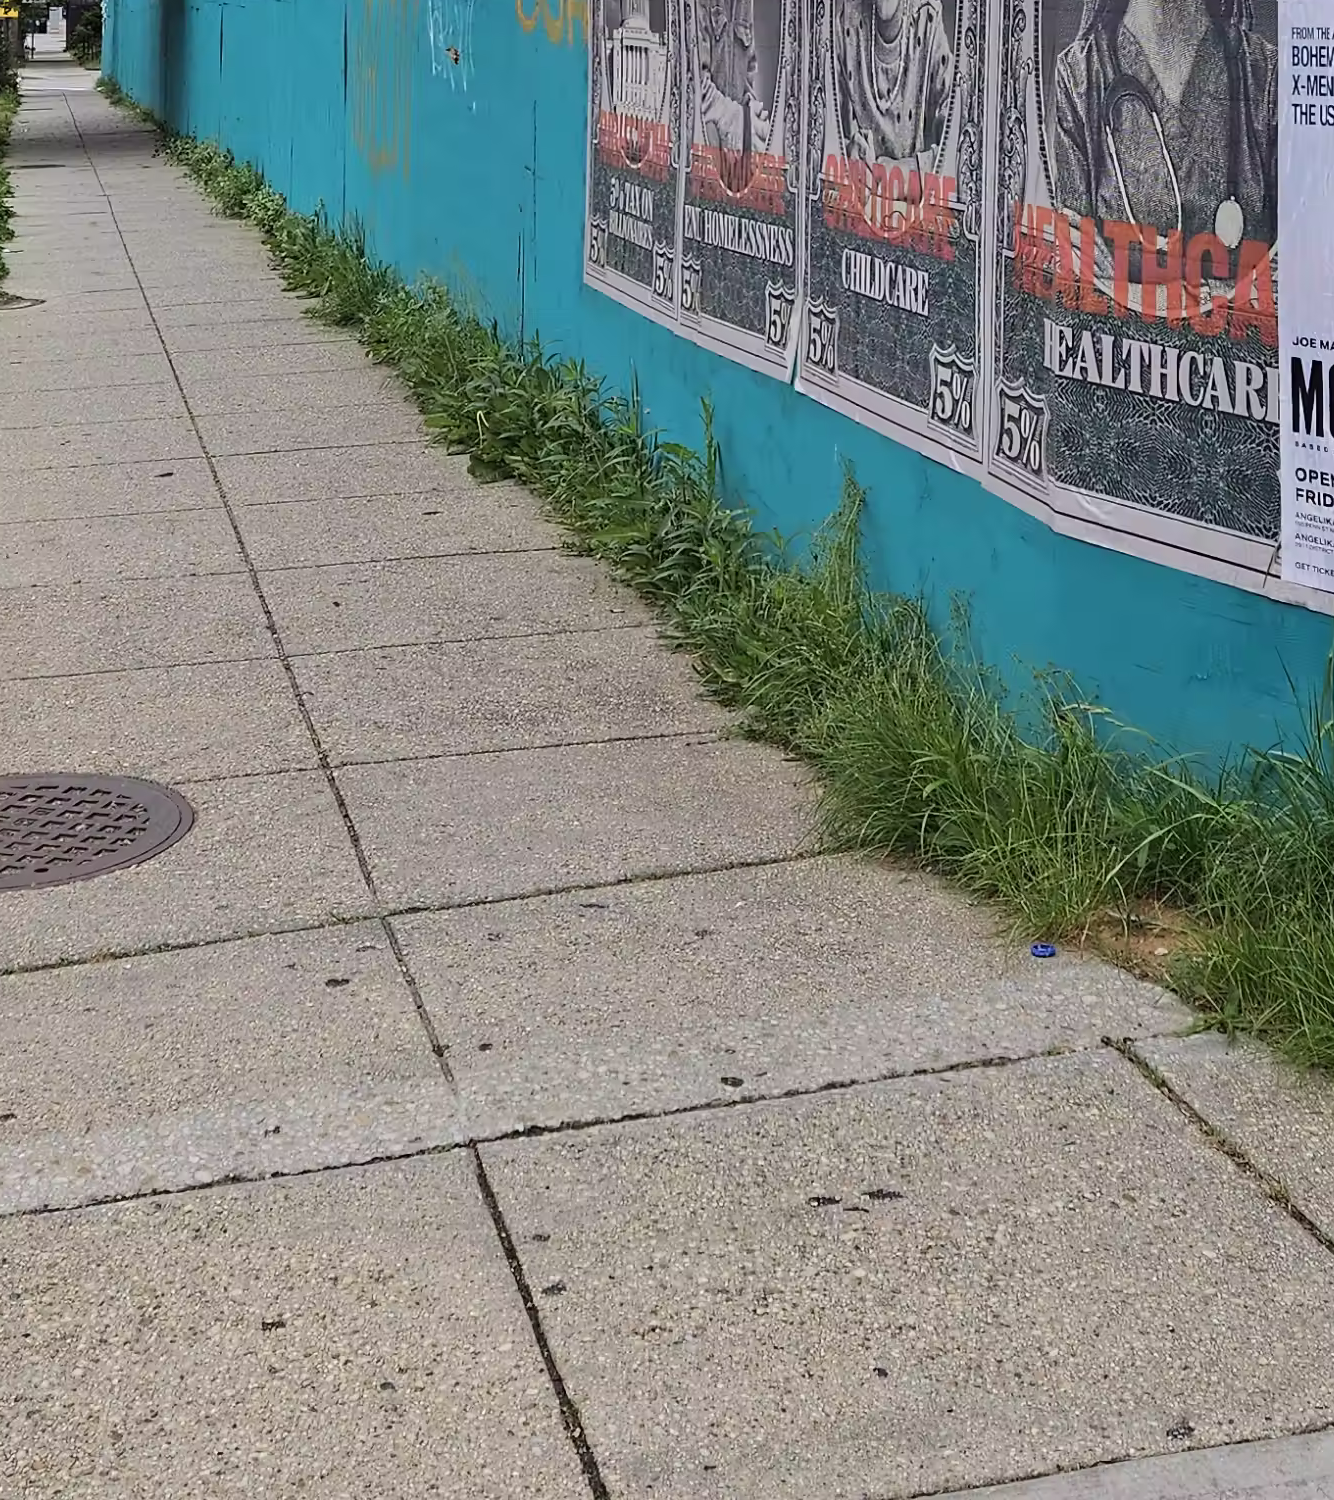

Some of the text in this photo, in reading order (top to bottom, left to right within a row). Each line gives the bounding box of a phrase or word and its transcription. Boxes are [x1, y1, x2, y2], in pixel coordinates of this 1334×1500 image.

[1292, 74, 1334, 97] X-MEN
[1292, 103, 1316, 126] THE
[703, 212, 794, 267] HOMELESSNESS
[841, 248, 930, 318] CHILDCARE
[808, 315, 835, 372] 5%
[934, 365, 972, 431] 5%
[1000, 400, 1042, 473] 5%
